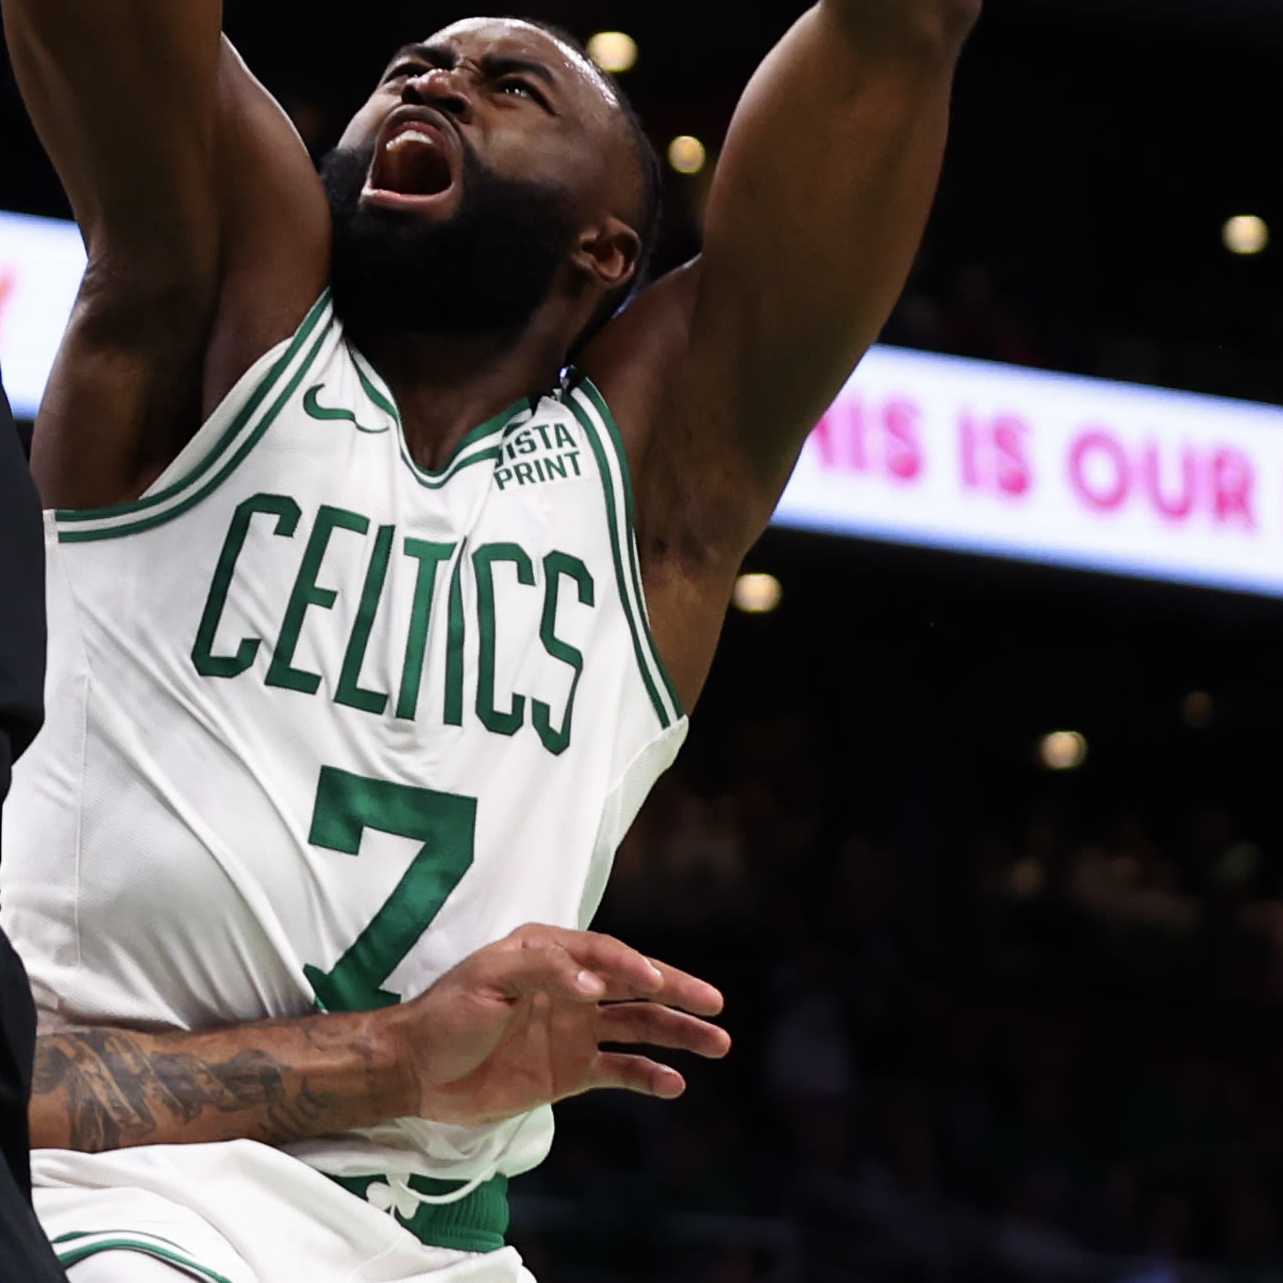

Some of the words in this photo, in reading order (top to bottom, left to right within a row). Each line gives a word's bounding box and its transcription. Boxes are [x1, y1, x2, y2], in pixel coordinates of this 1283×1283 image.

[494, 450, 582, 491] PRINT
[959, 416, 1034, 502] IS
[1066, 429, 1257, 529] OUR
[191, 492, 595, 757] CELTICS
[303, 765, 478, 1013] 7
